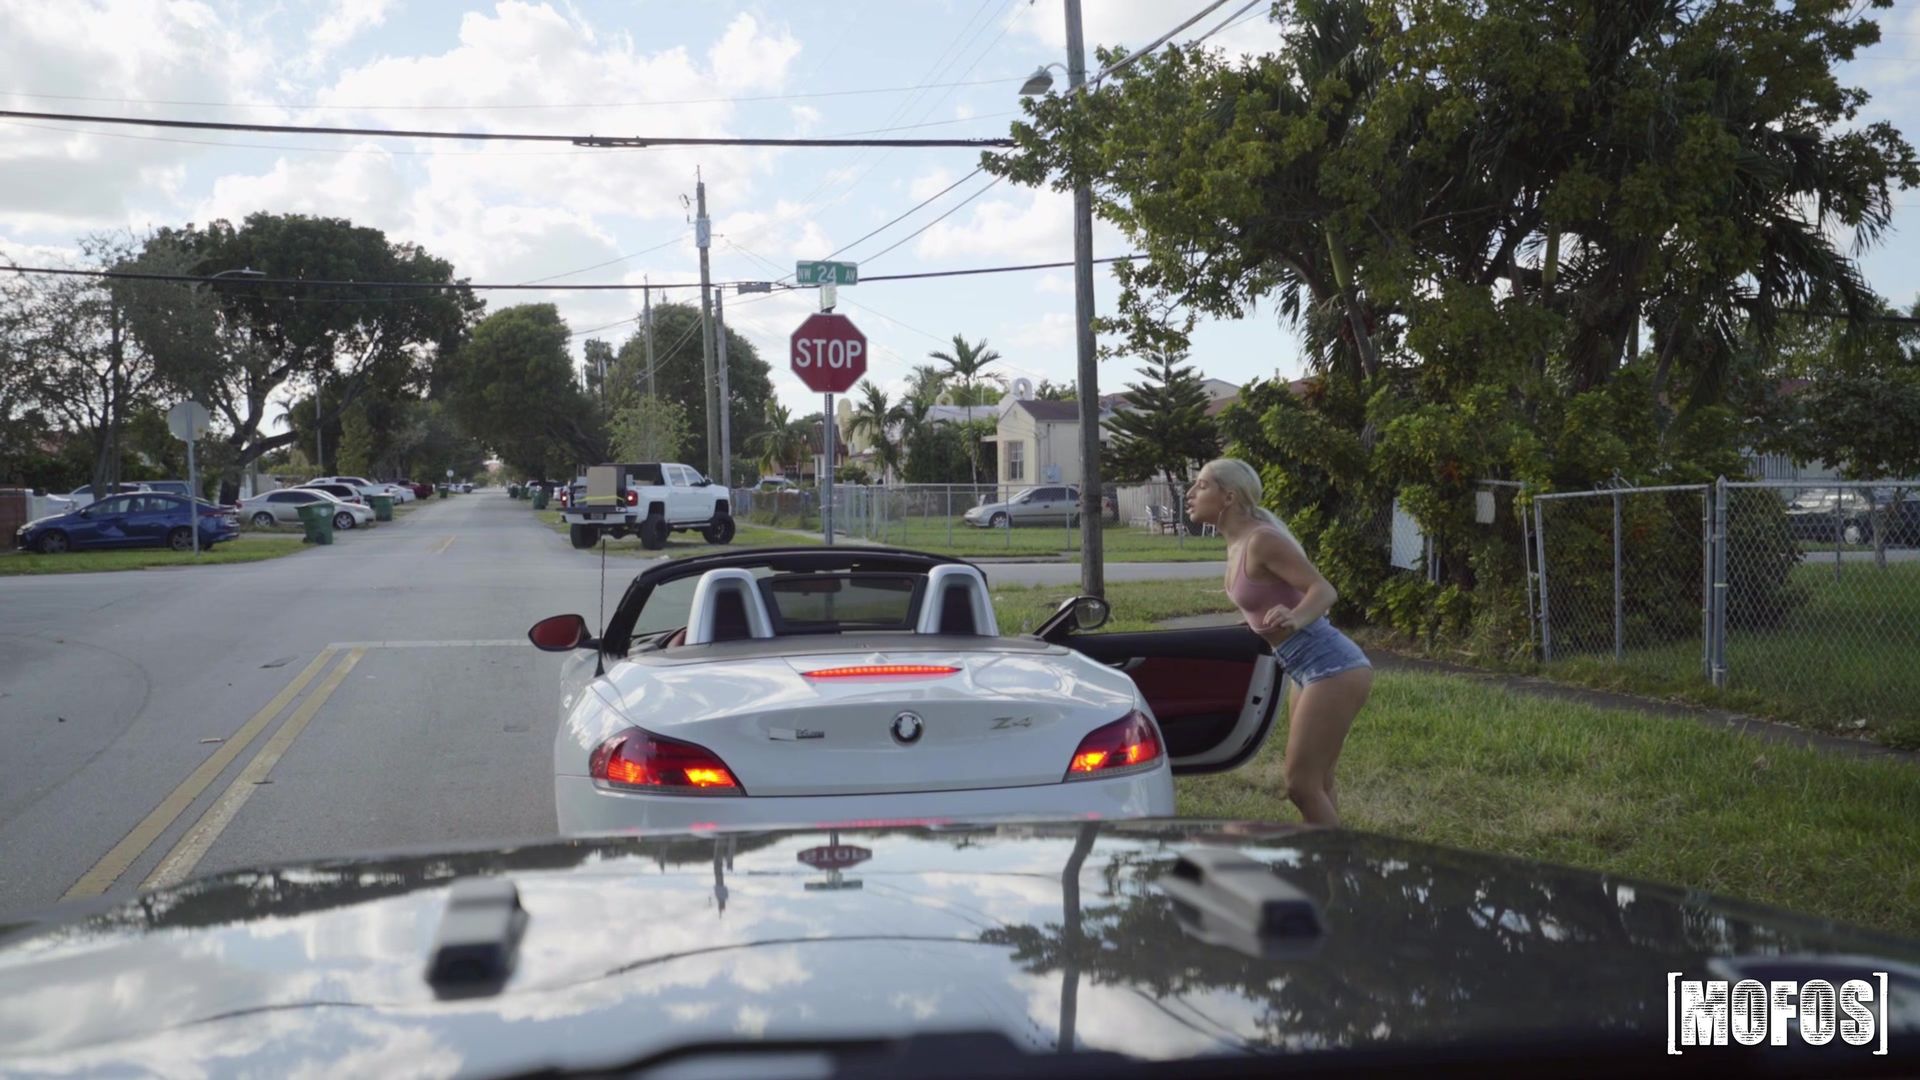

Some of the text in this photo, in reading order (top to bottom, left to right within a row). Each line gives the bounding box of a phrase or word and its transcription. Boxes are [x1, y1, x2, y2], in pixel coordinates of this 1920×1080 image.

[797, 265, 856, 283] NW 24 AV
[795, 338, 862, 369] STOP
[990, 716, 1033, 730] Z4
